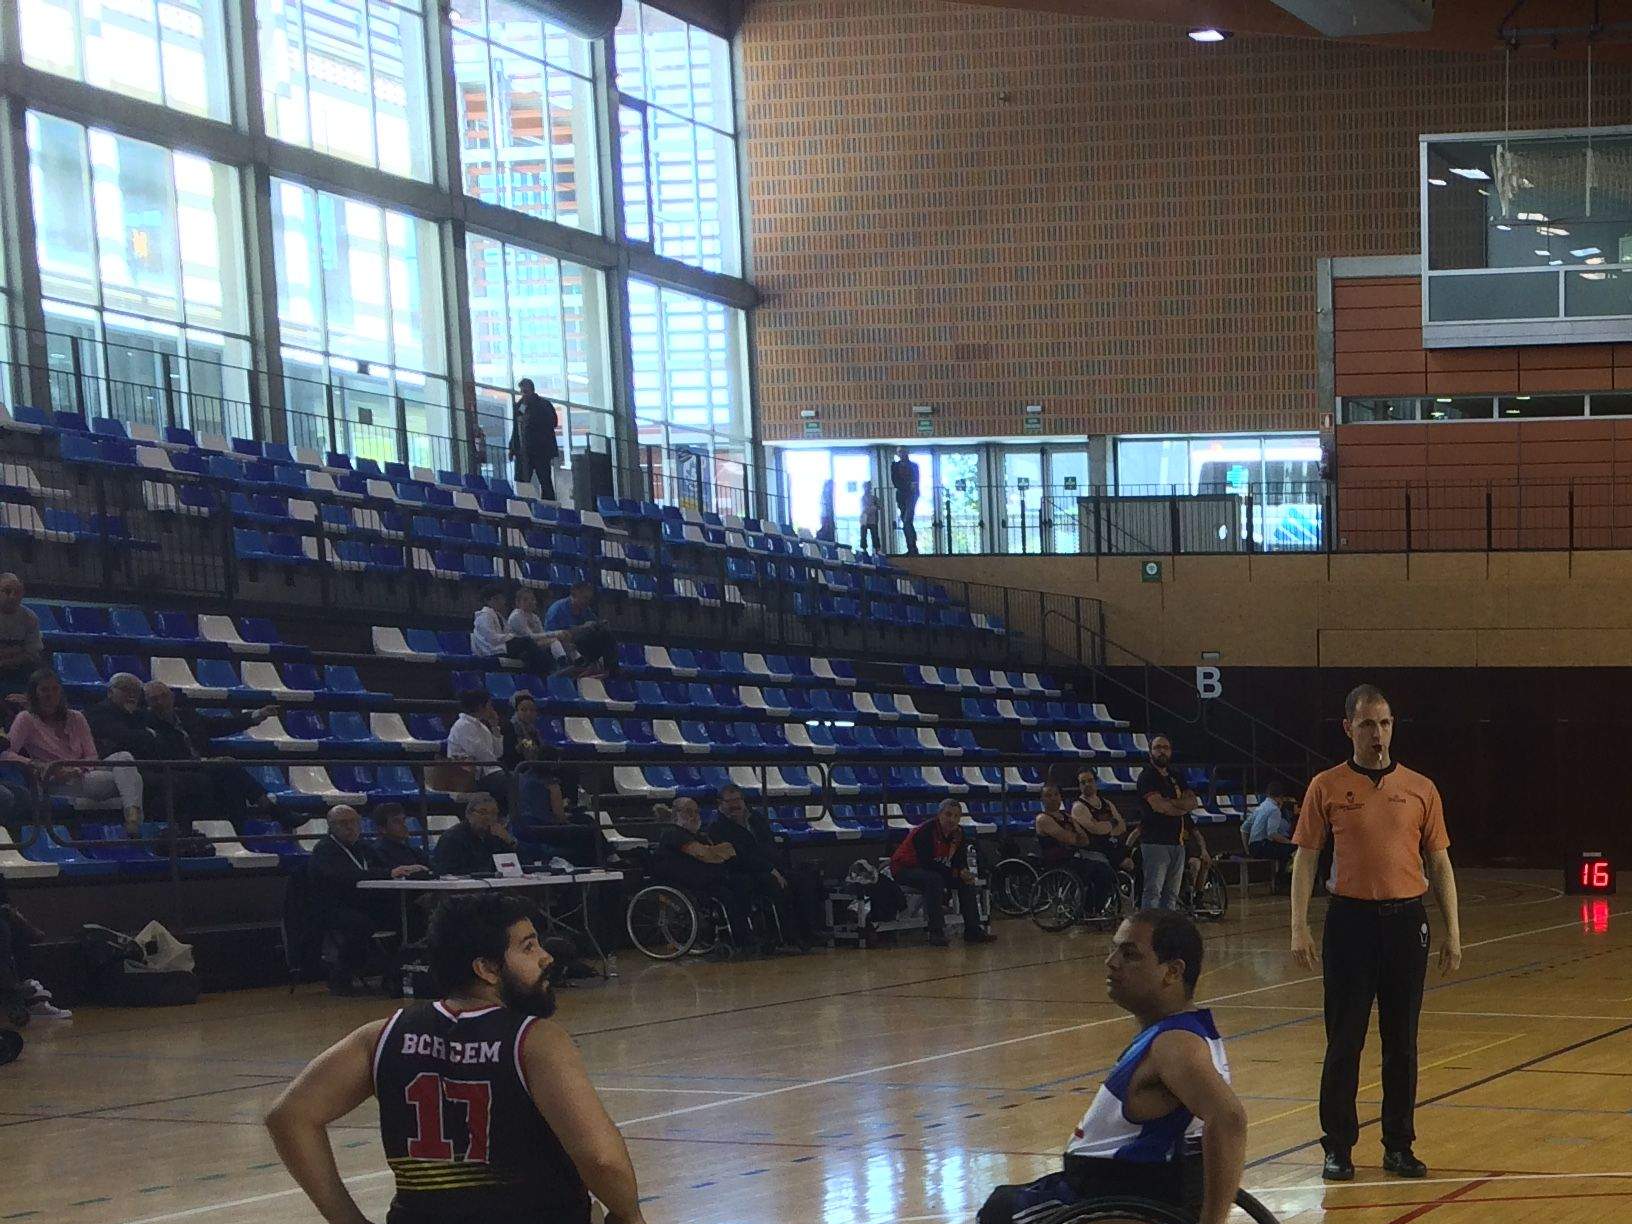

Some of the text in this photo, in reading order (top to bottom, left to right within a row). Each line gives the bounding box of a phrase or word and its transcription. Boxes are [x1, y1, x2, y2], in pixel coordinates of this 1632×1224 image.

[1196, 666, 1222, 699] B
[1583, 862, 1608, 887] 16
[404, 1071, 493, 1164] 17
